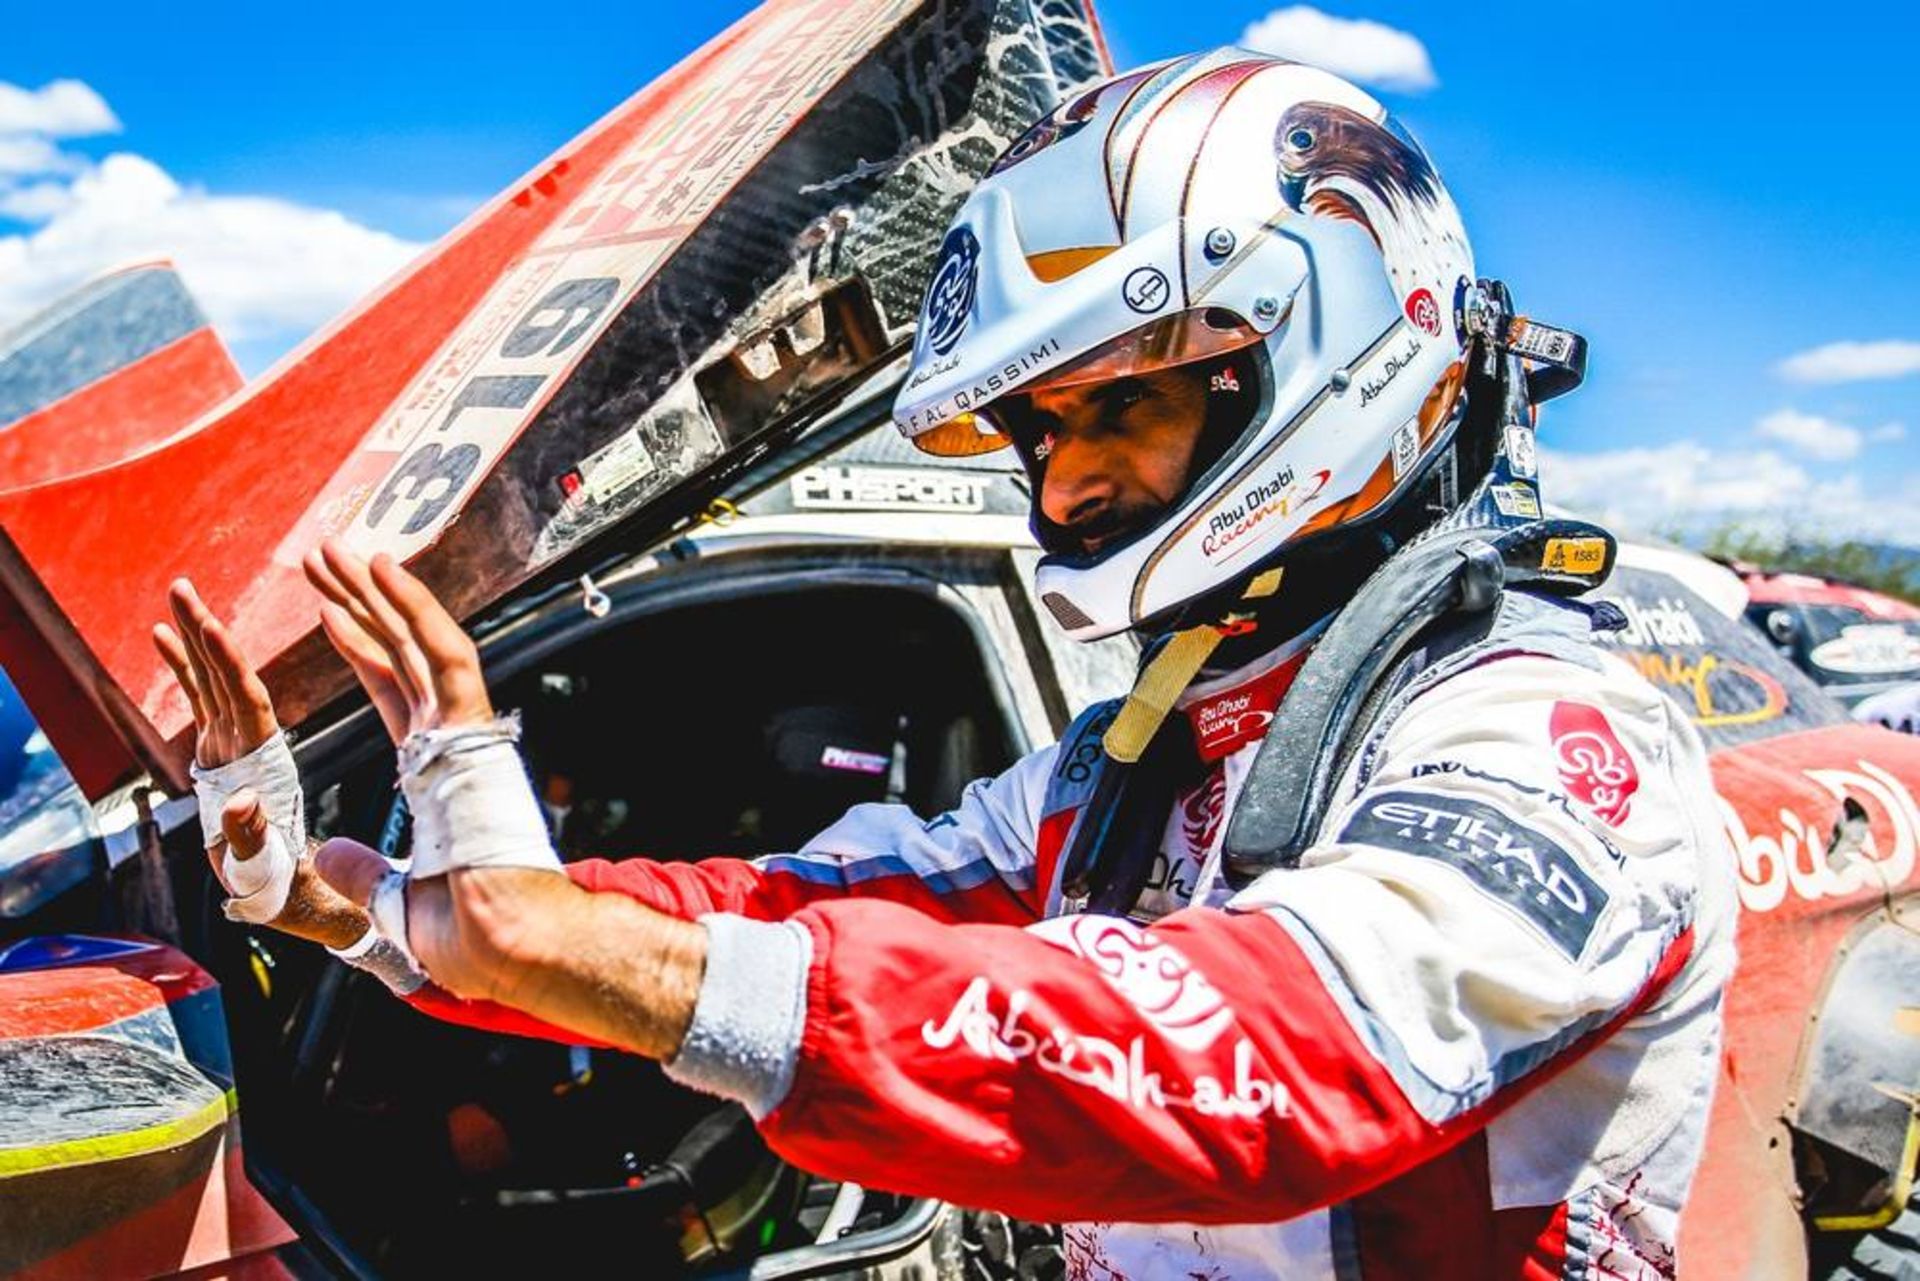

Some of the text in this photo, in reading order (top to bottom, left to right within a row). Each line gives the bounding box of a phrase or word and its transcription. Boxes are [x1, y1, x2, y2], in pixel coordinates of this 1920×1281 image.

[366, 276, 621, 535] 319
[926, 406, 948, 425] AL
[953, 337, 1062, 411] QASSIMI
[1201, 495, 1290, 558] Racing
[1208, 463, 1295, 537] Abu Dhabi
[1371, 802, 1588, 915] ETIHAD
[1396, 826, 1552, 908] AIRWAYS
